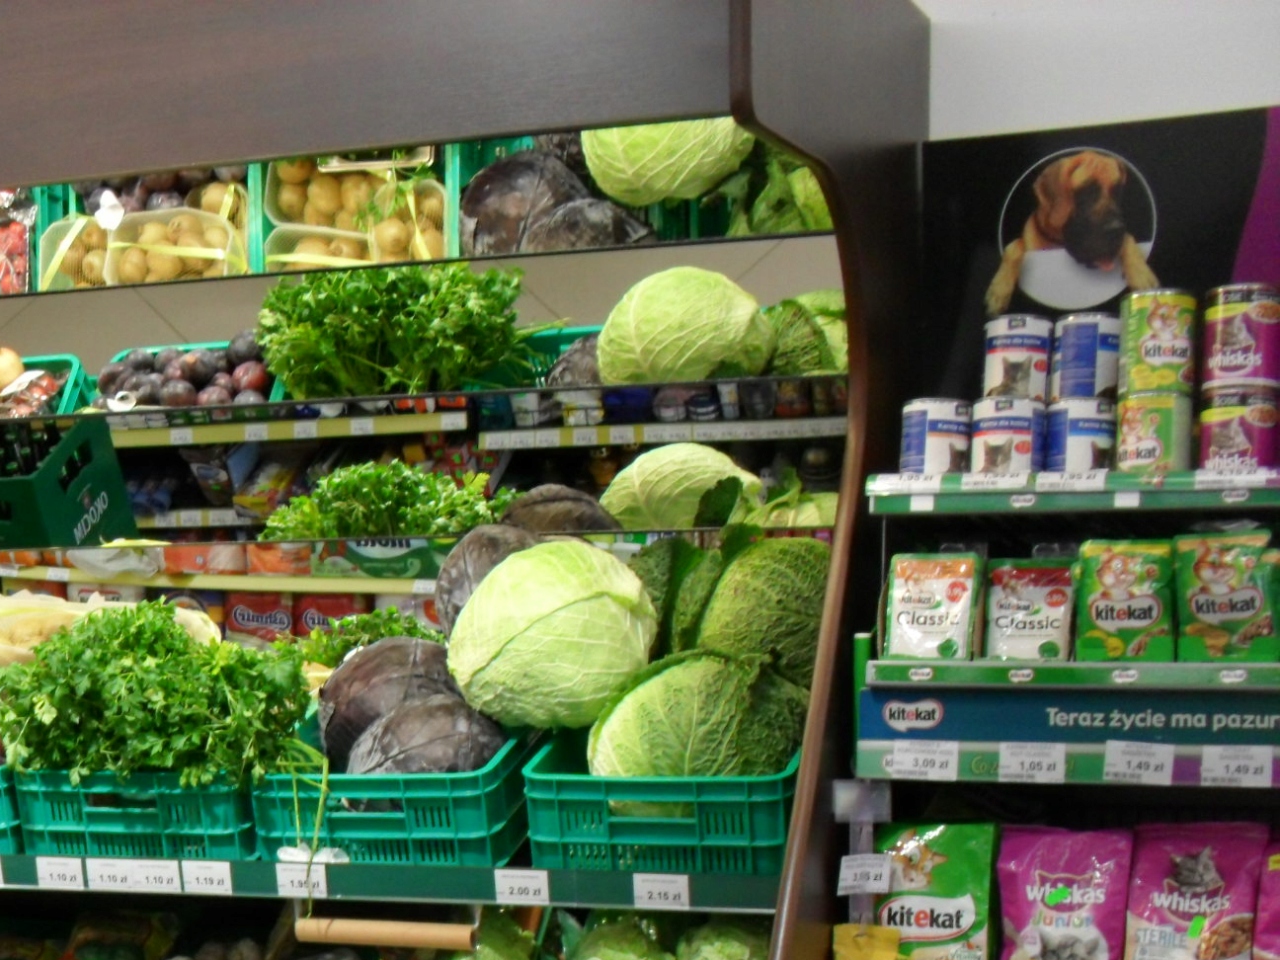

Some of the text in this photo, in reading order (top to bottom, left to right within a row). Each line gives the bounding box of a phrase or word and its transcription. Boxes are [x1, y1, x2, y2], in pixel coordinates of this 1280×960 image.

[1144, 346, 1189, 358] kitekat
[1209, 350, 1262, 369] whiskas
[1195, 596, 1256, 614] kitekat
[897, 611, 959, 626] Classic
[1095, 605, 1154, 621] kitekat
[995, 616, 1061, 630] Classic
[889, 708, 937, 721] kitekat
[1046, 707, 1280, 732] Teraz życie ma pazur
[912, 757, 936, 770] 3,09
[1019, 761, 1043, 773] 1,05
[1126, 760, 1151, 772] 1,49
[1224, 764, 1250, 776] 1,49
[1026, 882, 1106, 905] whkas
[1153, 891, 1231, 913] whiskas
[887, 906, 963, 929] kitekat
[1032, 909, 1093, 928] Junior
